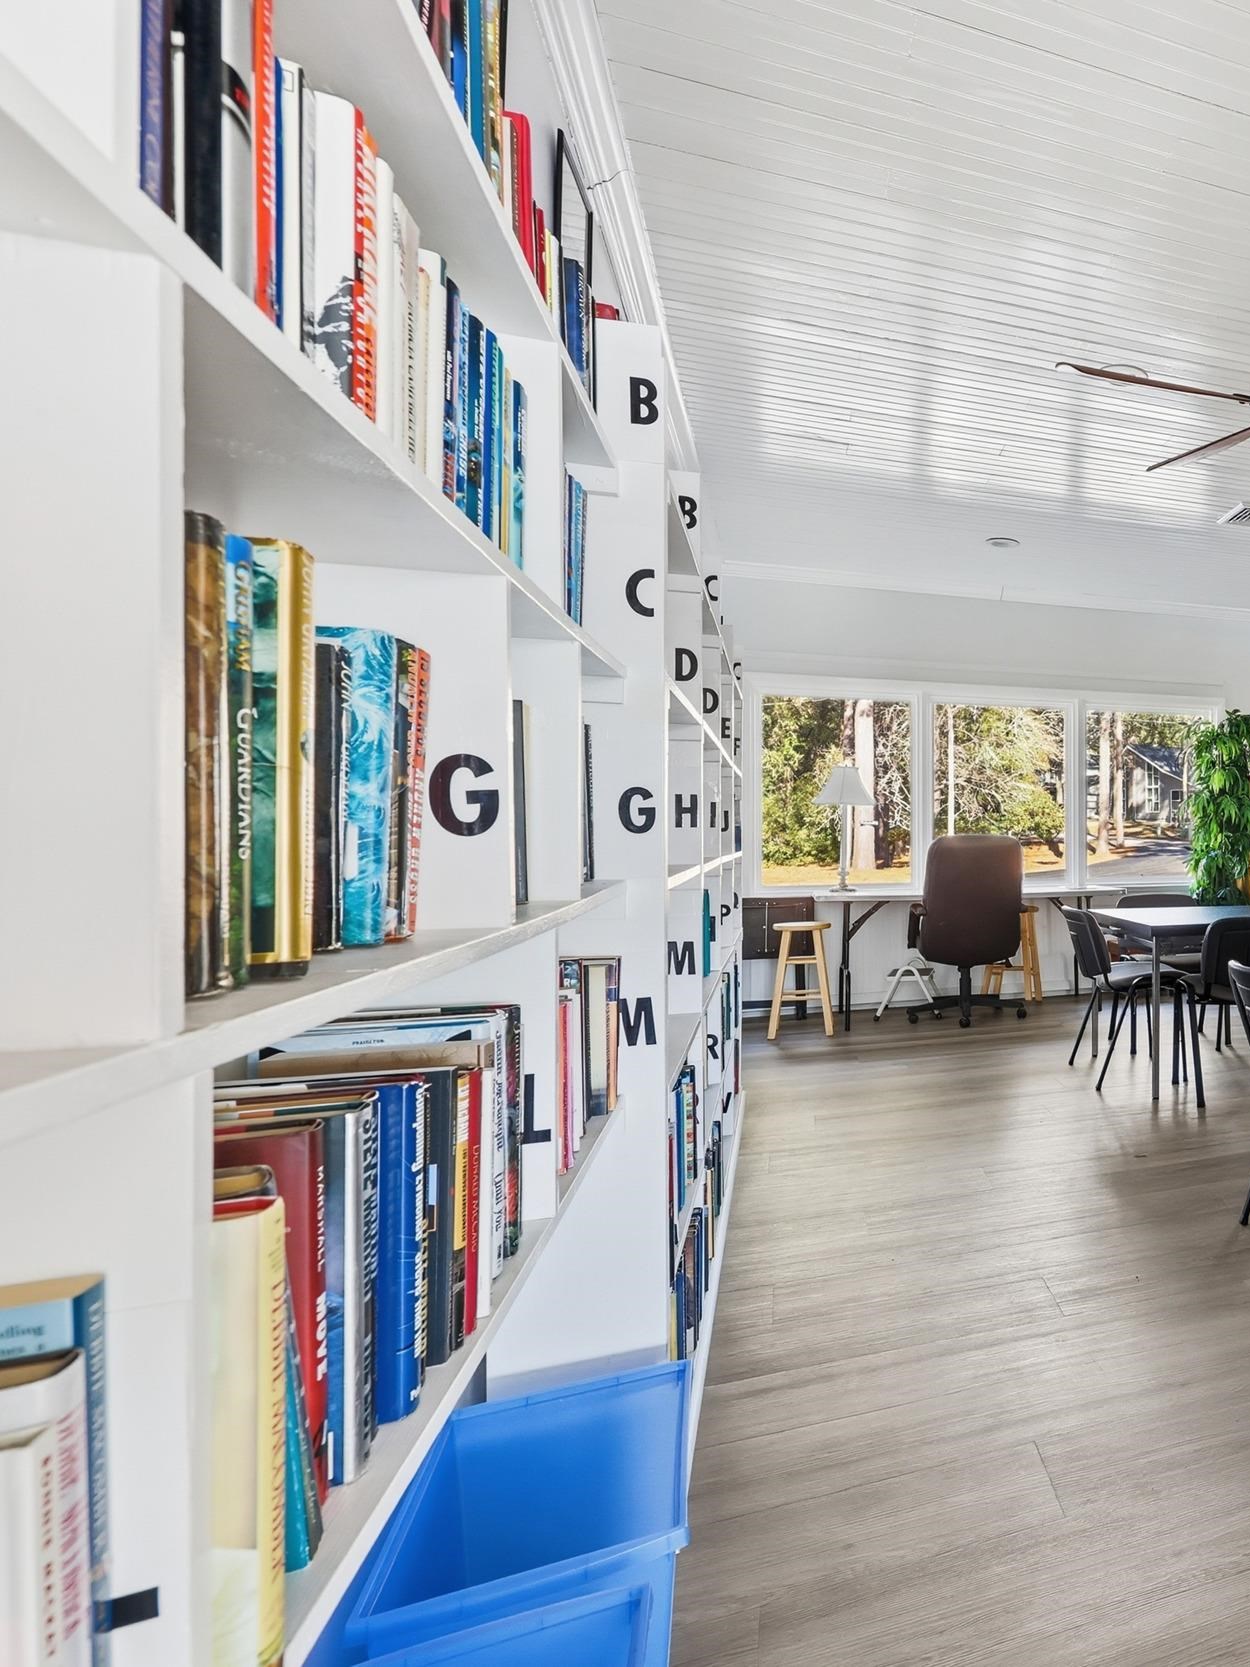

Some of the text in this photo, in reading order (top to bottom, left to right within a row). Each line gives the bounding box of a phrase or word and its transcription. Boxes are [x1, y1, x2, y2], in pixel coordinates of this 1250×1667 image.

[630, 376, 658, 425] B
[678, 495, 698, 530] B
[625, 568, 655, 618] C
[704, 575, 719, 602] C
[340, 660, 352, 711] JOHN
[674, 648, 698, 682] D
[702, 688, 719, 714] D
[721, 718, 730, 738] E
[733, 738, 740, 756] F
[235, 708, 258, 860] GUARDIANS
[412, 768, 424, 837] ANDREW
[428, 754, 500, 837] G
[618, 786, 656, 834] G
[674, 794, 698, 828] H
[720, 904, 730, 926] P
[667, 941, 696, 975] M
[619, 996, 657, 1046] M
[706, 1034, 719, 1060] R
[522, 1074, 552, 1145] L
[472, 1144, 480, 1196] DONALD
[316, 1166, 328, 1382] MARSHALL MOVE
